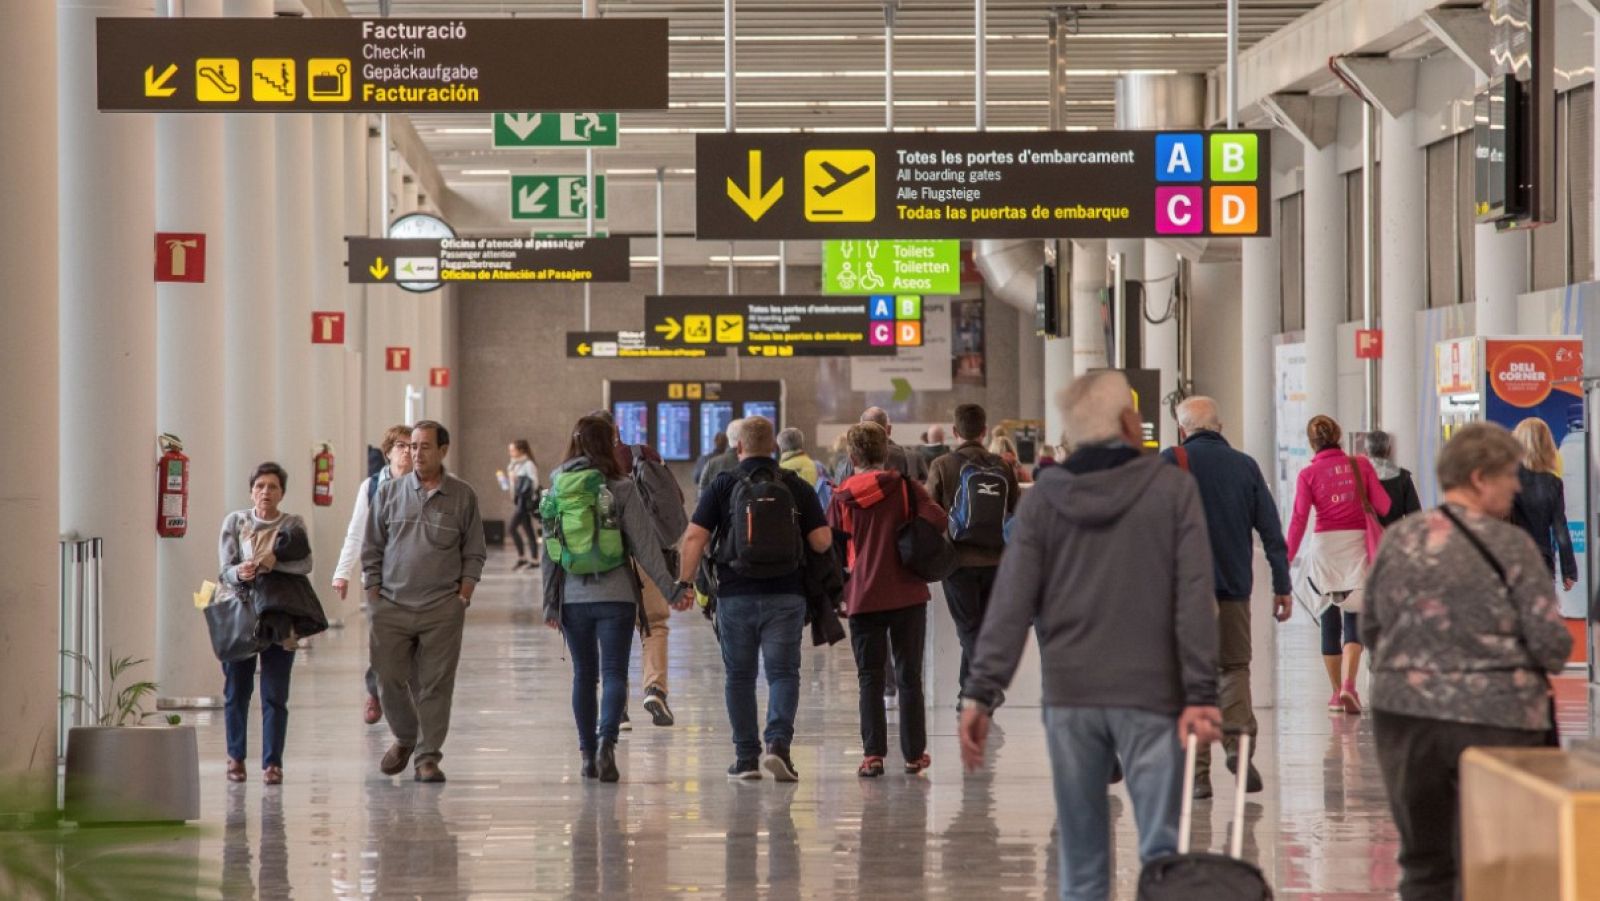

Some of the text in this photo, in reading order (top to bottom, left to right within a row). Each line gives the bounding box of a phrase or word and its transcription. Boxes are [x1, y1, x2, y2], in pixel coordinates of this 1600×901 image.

[362, 21, 467, 39] Facturació
[362, 43, 425, 59] Check-in
[362, 63, 478, 82] Gepäckaufgabe
[362, 84, 479, 102] Facturación
[897, 149, 1134, 166] Totes les portes d'embarcament
[1166, 142, 1245, 173] A B
[897, 168, 1001, 183] All boarding gates
[897, 186, 980, 201] Alle Flugsteige
[897, 205, 1130, 222] Todas las puertas de embarque
[1166, 194, 1246, 226] C D
[441, 238, 586, 250] Oficina d'atenció al passatger
[893, 245, 935, 258] Toilets
[441, 250, 481, 259] Passenger
[893, 260, 949, 273] Toiletten
[441, 269, 592, 281] Oficina de Atención al Pasajero
[893, 277, 932, 289] Aseos
[875, 299, 914, 316] A B
[875, 324, 889, 341] C
[902, 324, 914, 341] D
[1510, 362, 1536, 372] DELI
[1499, 371, 1546, 382] CORNER
